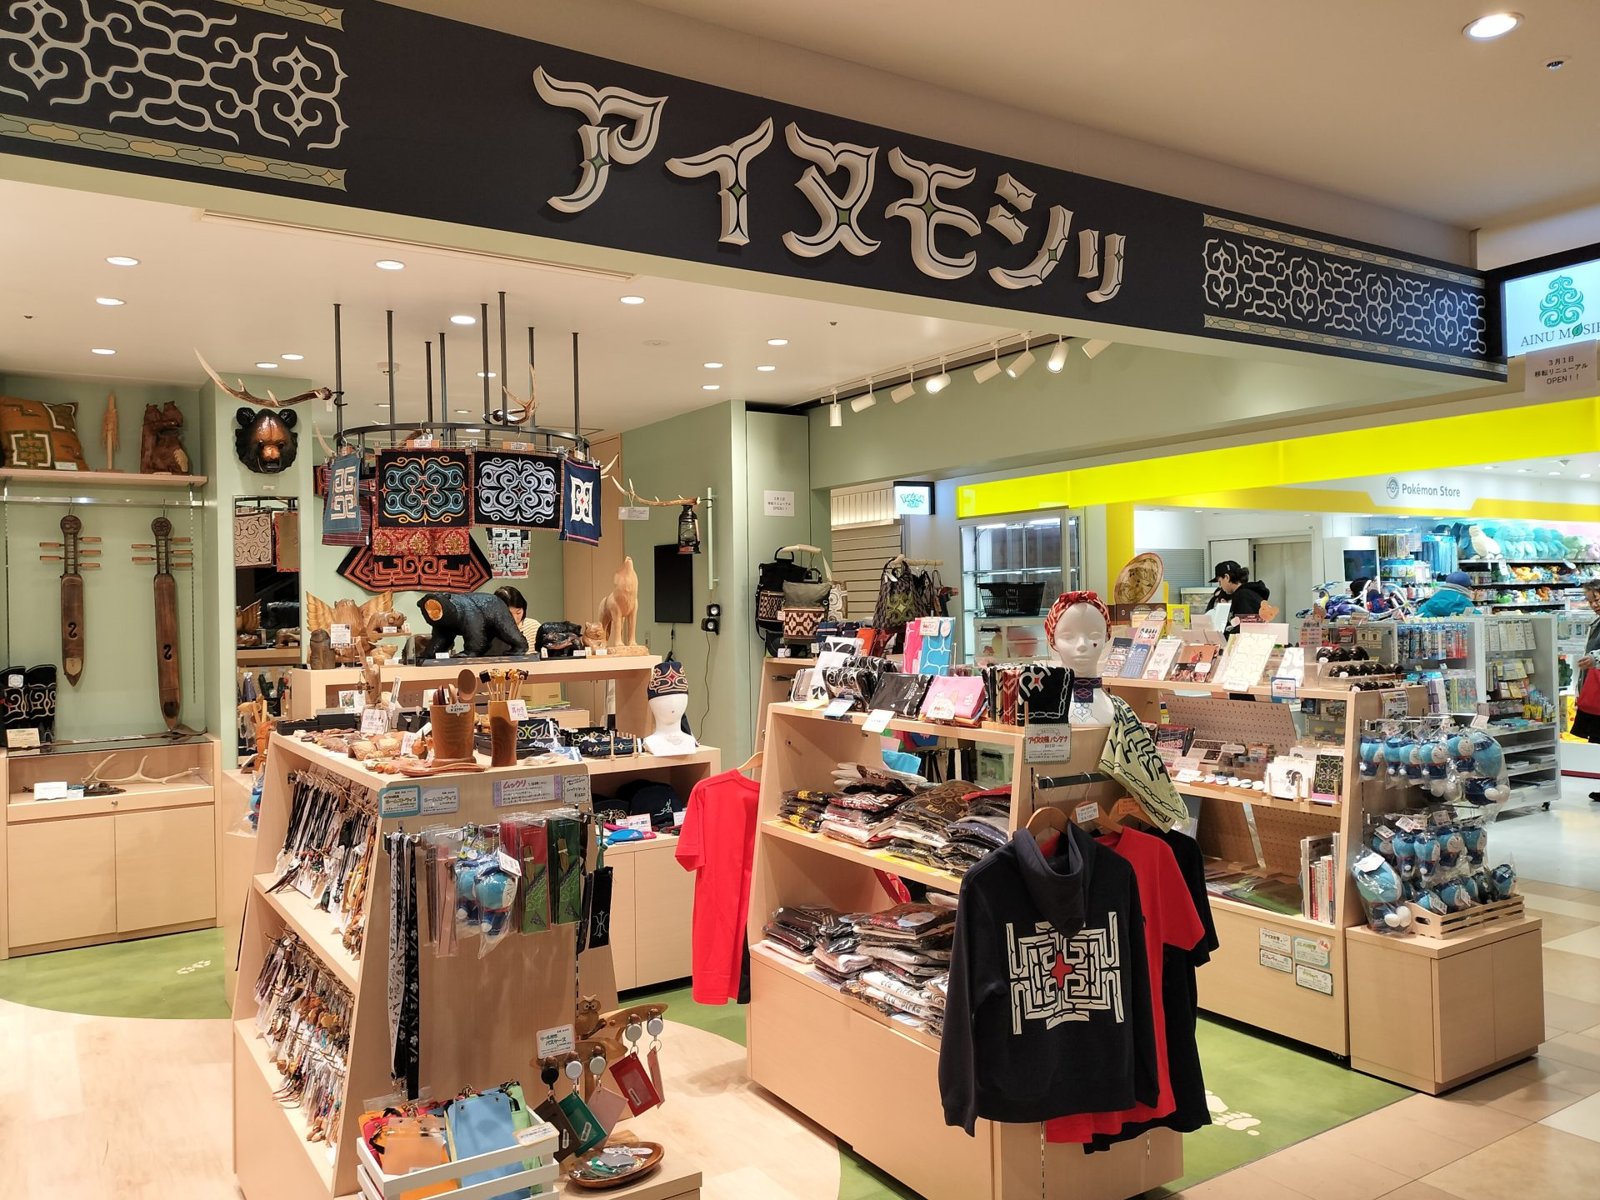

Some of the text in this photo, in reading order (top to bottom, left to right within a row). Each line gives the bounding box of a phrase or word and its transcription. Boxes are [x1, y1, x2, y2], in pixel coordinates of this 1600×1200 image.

[1521, 331, 1555, 347] AINU
[1401, 483, 1460, 497] Pokémon Store
[503, 779, 526, 789] ムックリ
